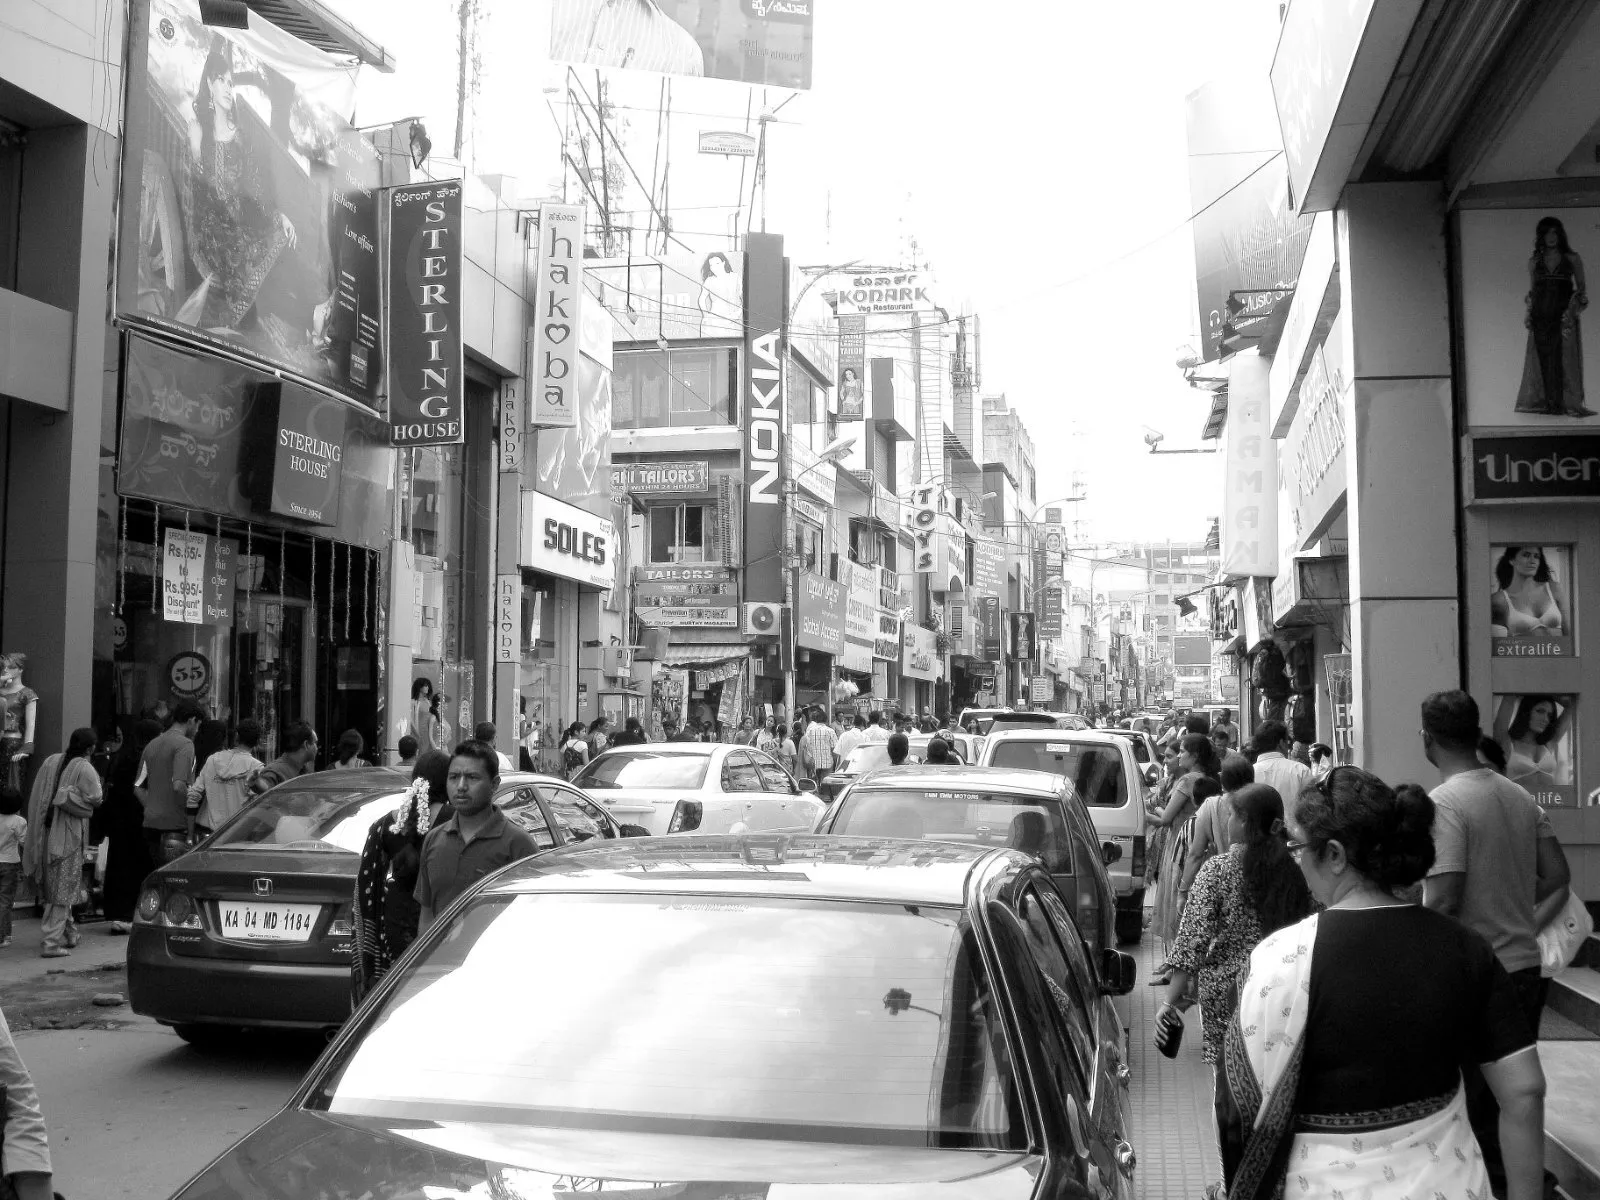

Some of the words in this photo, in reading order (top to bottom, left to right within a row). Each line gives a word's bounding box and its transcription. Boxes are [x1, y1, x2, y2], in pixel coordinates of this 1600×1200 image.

[344, 225, 358, 241] Love
[357, 231, 374, 254] affairs
[839, 287, 930, 306] KONARK
[420, 201, 450, 418] STERLING
[857, 304, 871, 312] Veg
[873, 303, 913, 312] Restaurant
[505, 384, 515, 464] hakoba
[750, 328, 780, 503] NOKIA
[393, 421, 459, 440] HOUSE
[279, 428, 341, 462] STERLING
[290, 455, 328, 479] HOUSE
[640, 470, 695, 484] TAILORS
[290, 502, 306, 516] Since
[307, 509, 322, 520] 1954
[916, 490, 935, 569] TOYS
[544, 518, 605, 565] SOLES
[179, 564, 188, 576] to
[646, 570, 714, 580] TAILORS
[165, 580, 202, 596] Rs.995/-
[502, 581, 512, 658] hakoba
[820, 621, 840, 642] Access
[1497, 641, 1561, 656] extralife
[174, 665, 204, 681] 55
[225, 912, 238, 928] KA
[244, 910, 257, 928] 04
[263, 912, 278, 930] MD
[284, 912, 310, 931] 1184
